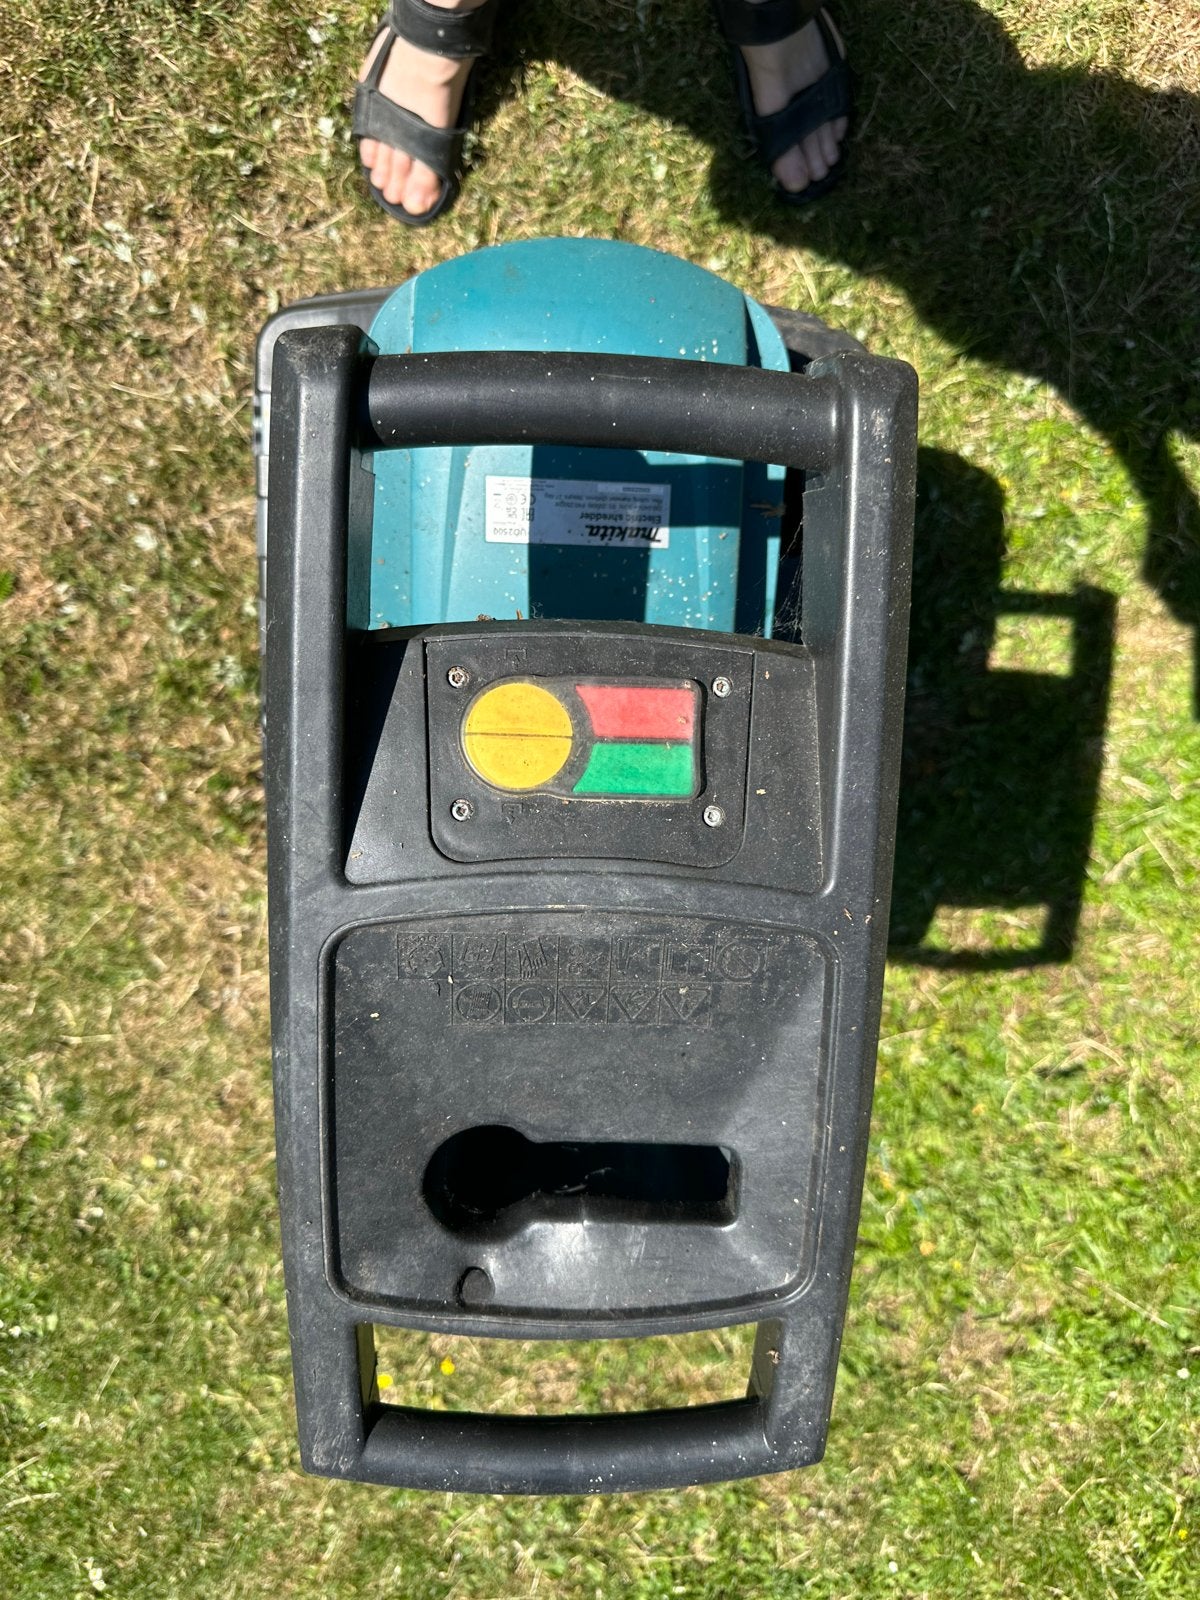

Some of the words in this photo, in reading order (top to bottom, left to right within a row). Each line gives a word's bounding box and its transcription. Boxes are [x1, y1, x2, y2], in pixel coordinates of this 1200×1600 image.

[580, 512, 623, 522] shredder
[626, 513, 662, 524] Electric
[585, 525, 661, 542] makita
